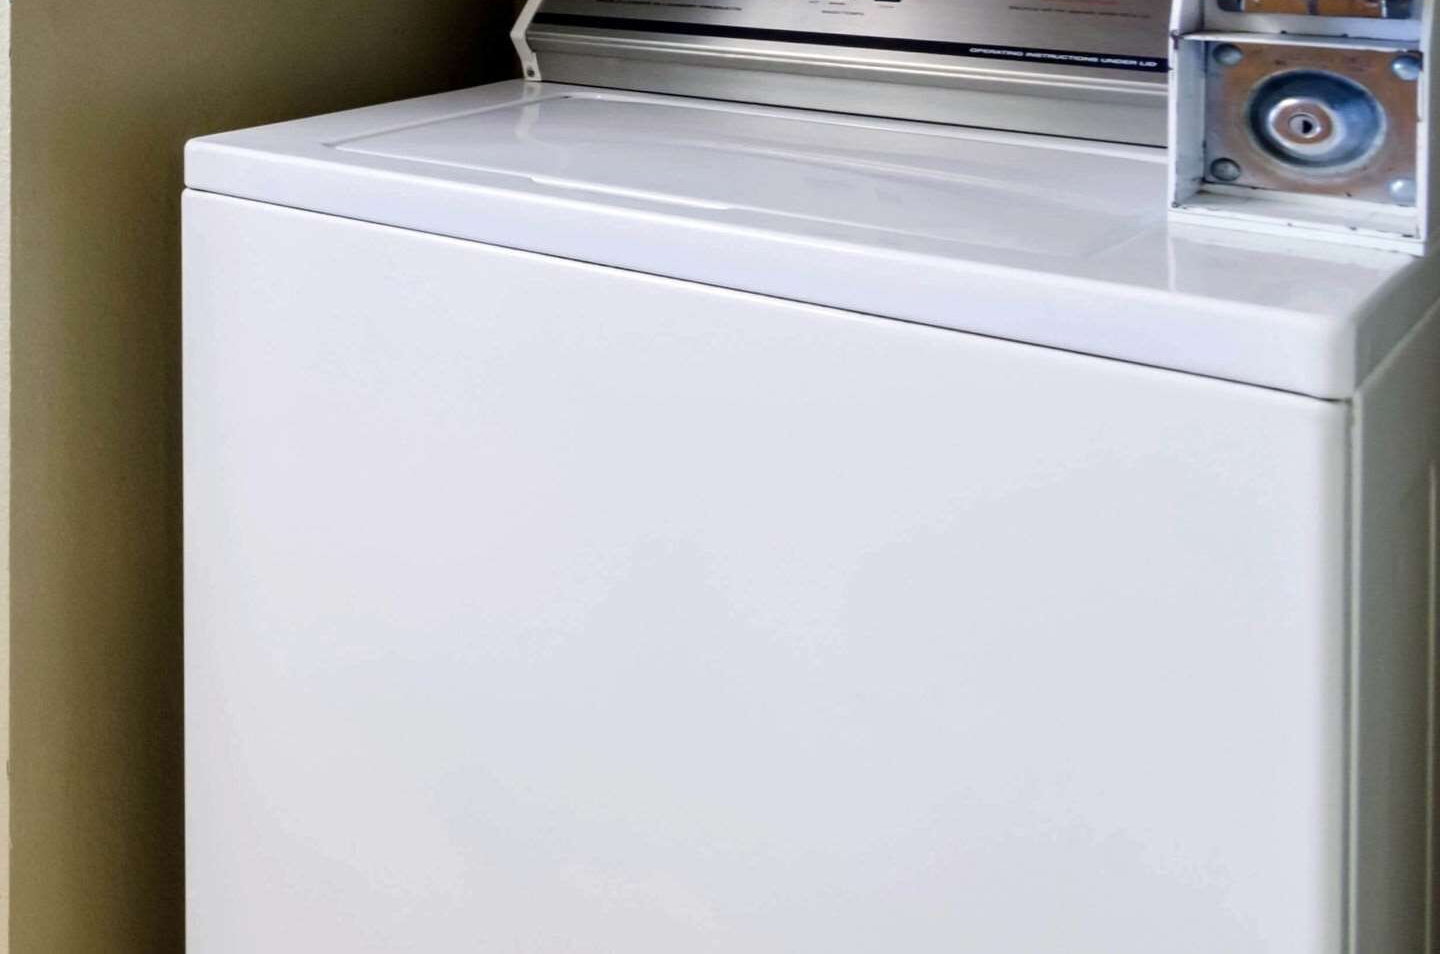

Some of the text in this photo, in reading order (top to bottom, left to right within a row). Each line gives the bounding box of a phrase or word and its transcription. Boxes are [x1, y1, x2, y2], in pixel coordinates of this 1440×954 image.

[969, 47, 1158, 68] OPERATING INSTRUCTIONS UNDER LID
